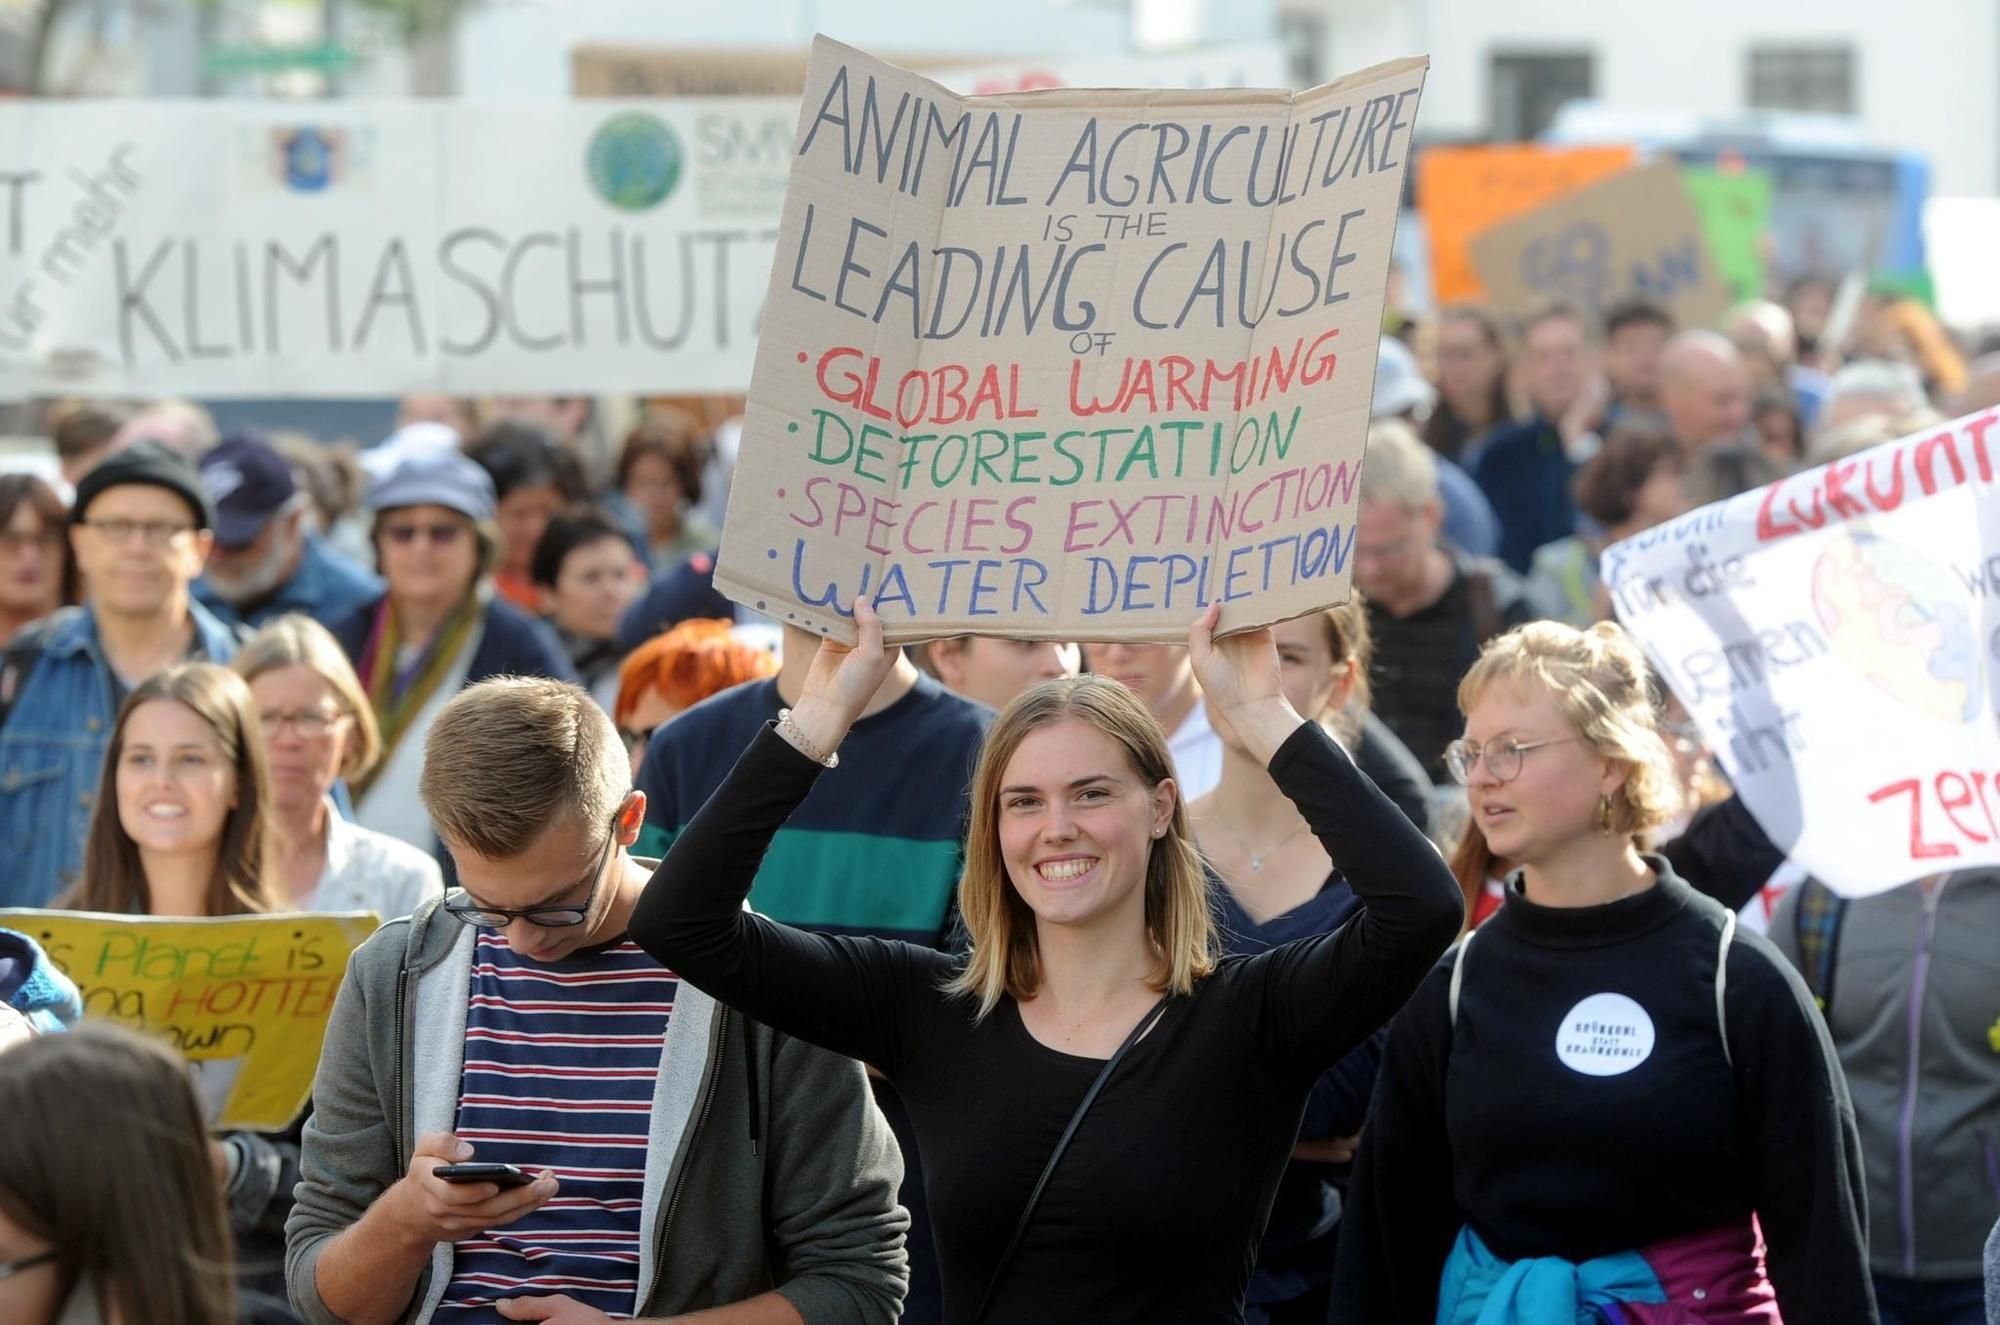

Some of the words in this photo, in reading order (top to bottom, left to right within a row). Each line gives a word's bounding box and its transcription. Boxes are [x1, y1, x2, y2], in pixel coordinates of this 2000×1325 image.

[799, 65, 1028, 208] ANIMAL
[1045, 87, 1420, 208] AGRICULTURE
[791, 203, 1107, 340] LEADING
[1132, 208, 1367, 330] CAUSE
[1043, 213, 1078, 242] IS
[1095, 211, 1168, 240] THE
[815, 346, 1040, 429] GLOBAL
[1069, 328, 1340, 417] WARMING
[1069, 331, 1117, 357] OF
[807, 405, 1303, 489] DEFORESTATION
[789, 476, 1037, 556] SPECIES
[1063, 459, 1362, 553] EXTINCTION
[791, 537, 1049, 617] WATER
[1080, 523, 1357, 615] DEPLETION
[96, 930, 261, 980] Planet
[286, 930, 325, 971] is
